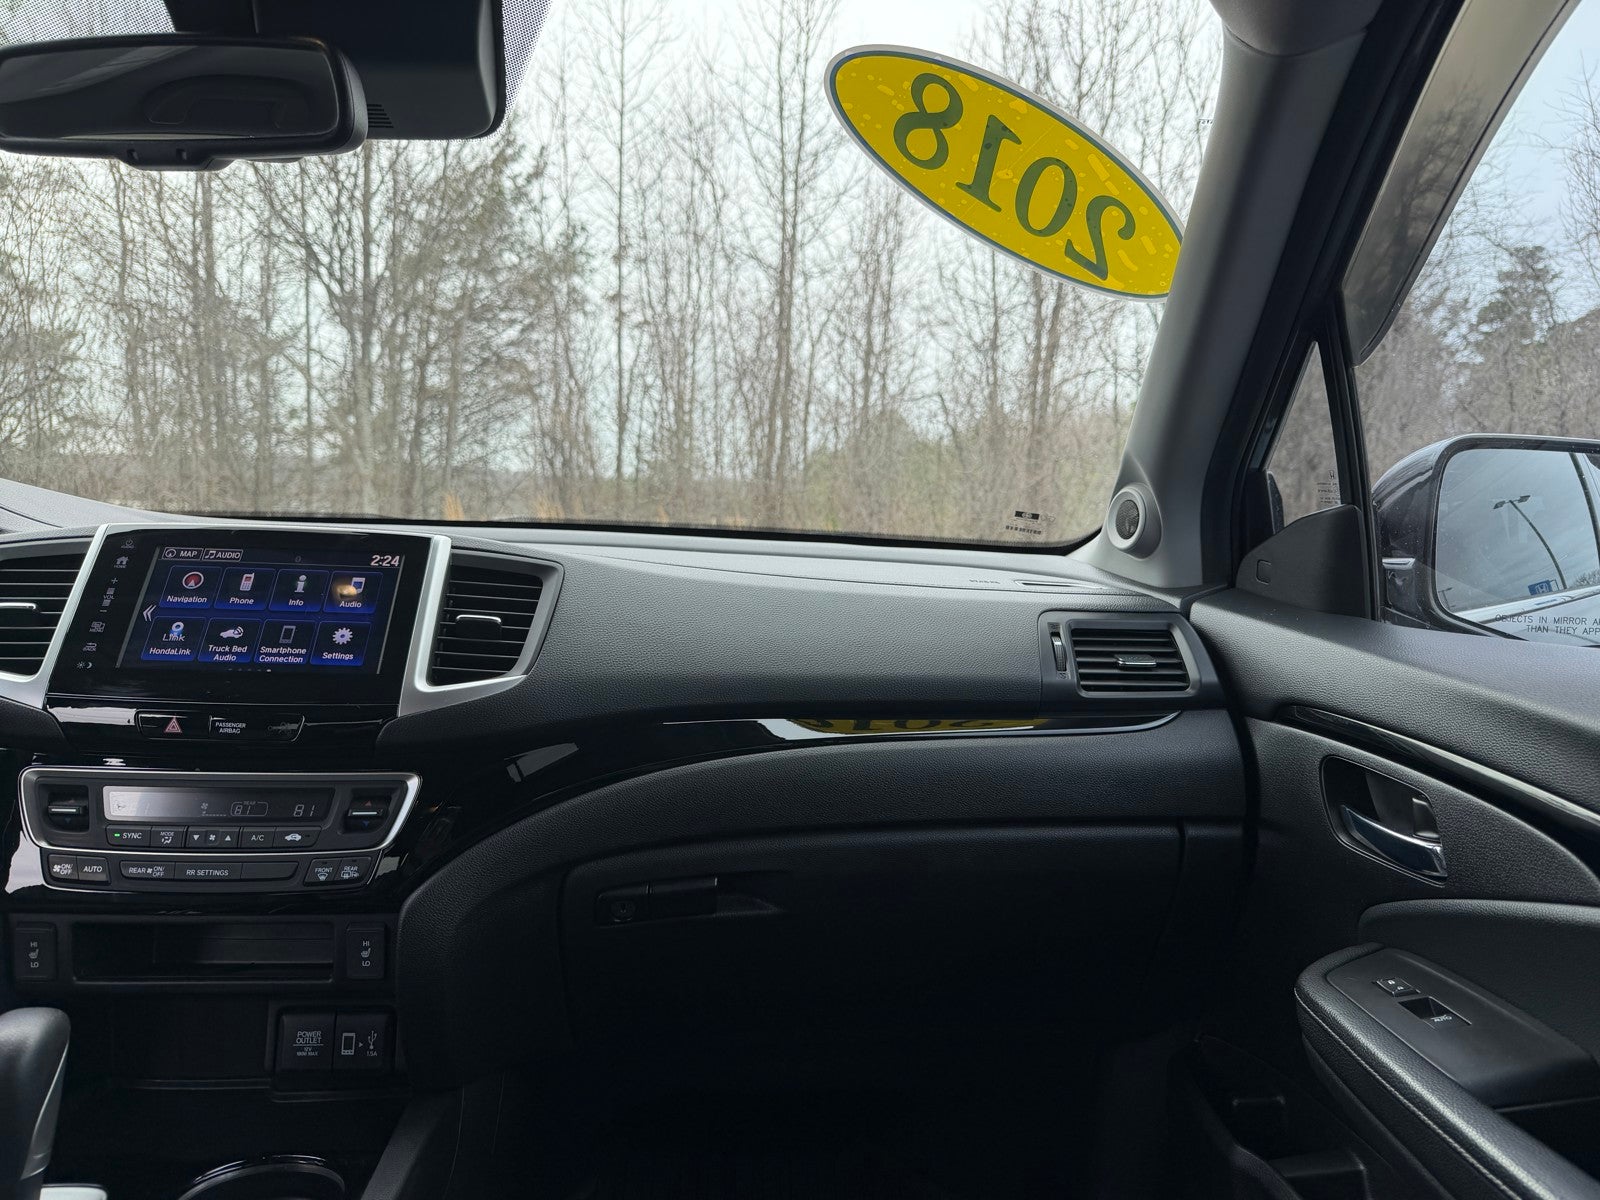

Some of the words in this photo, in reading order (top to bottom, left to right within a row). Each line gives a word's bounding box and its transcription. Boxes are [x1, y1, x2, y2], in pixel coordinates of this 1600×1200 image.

[216, 551, 241, 559] AUDIO
[370, 554, 400, 567] 2:24
[166, 595, 208, 604] Navigation
[229, 597, 255, 605] Phone
[288, 599, 304, 607] Info
[339, 600, 363, 609] Audio
[1495, 614, 1533, 624] OBJECTS
[1538, 616, 1548, 624] IN
[1553, 617, 1587, 626] MIRROR
[1526, 625, 1549, 633] THAN
[1555, 626, 1578, 635] THEY
[149, 647, 192, 656] HondaLink
[208, 644, 231, 653] Truck
[231, 645, 248, 653] Bed
[260, 646, 307, 656] Smartphone
[213, 654, 237, 662] Audio
[259, 655, 304, 664] Connection
[322, 652, 354, 661] Settings
[293, 804, 315, 817] 81
[250, 834, 265, 842] A/C
[60, 868, 73, 876] OFF
[83, 865, 103, 873] AUTO
[128, 867, 146, 875] REAR
[197, 869, 229, 877] SETTINGS
